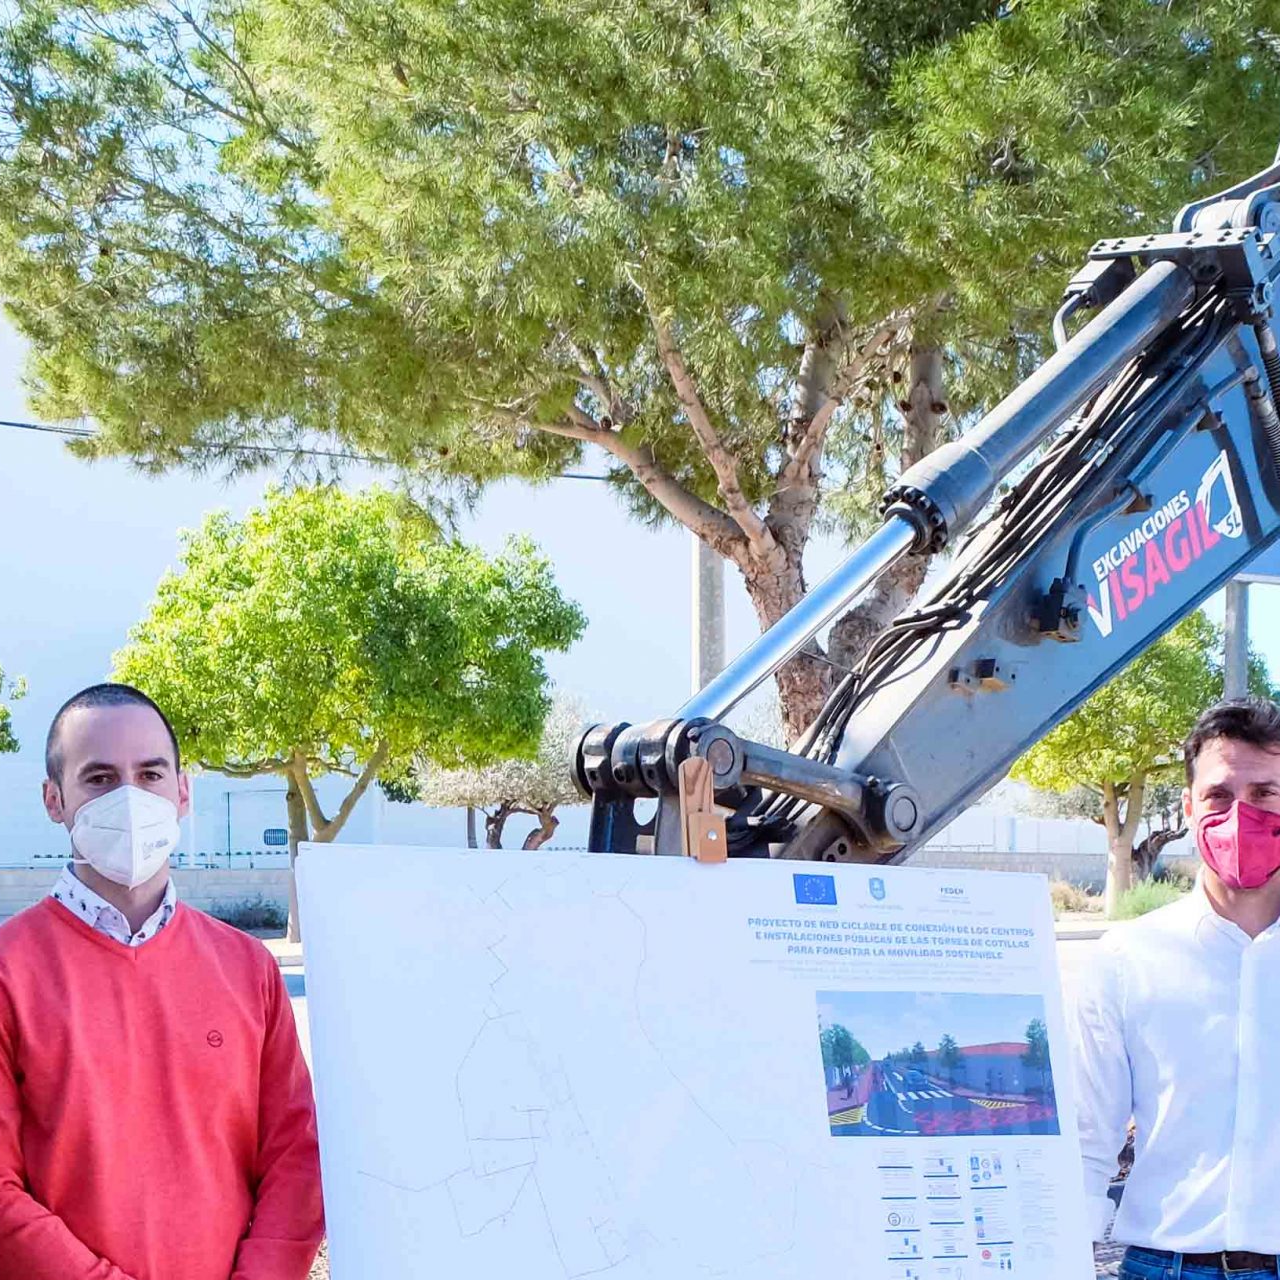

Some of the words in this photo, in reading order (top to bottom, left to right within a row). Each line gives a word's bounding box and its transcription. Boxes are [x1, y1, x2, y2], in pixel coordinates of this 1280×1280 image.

[1092, 489, 1191, 582] EXCAVACIONES
[1086, 500, 1220, 638] VISAGIL
[748, 917, 801, 928] PROYECTO
[804, 920, 817, 928] DE
[819, 920, 839, 929] RED
[841, 921, 887, 931] CICLABLE
[890, 923, 902, 931] DE
[905, 923, 955, 934] CONEXIÓN
[957, 926, 969, 934] DE
[971, 926, 989, 935] LOS
[991, 927, 1035, 937] CENTROS
[755, 931, 761, 940] E
[763, 932, 843, 942] INSTALACIONES
[895, 936, 907, 944] DE
[910, 936, 929, 945] LAS
[971, 939, 982, 947] DE
[985, 939, 1030, 948] COTILLAS
[787, 945, 814, 954] PARA
[816, 946, 871, 956] FOMENTAR
[873, 948, 885, 956] LA
[888, 948, 943, 957] MOVILIDAD
[945, 950, 1003, 960] SOSTENIBLE
